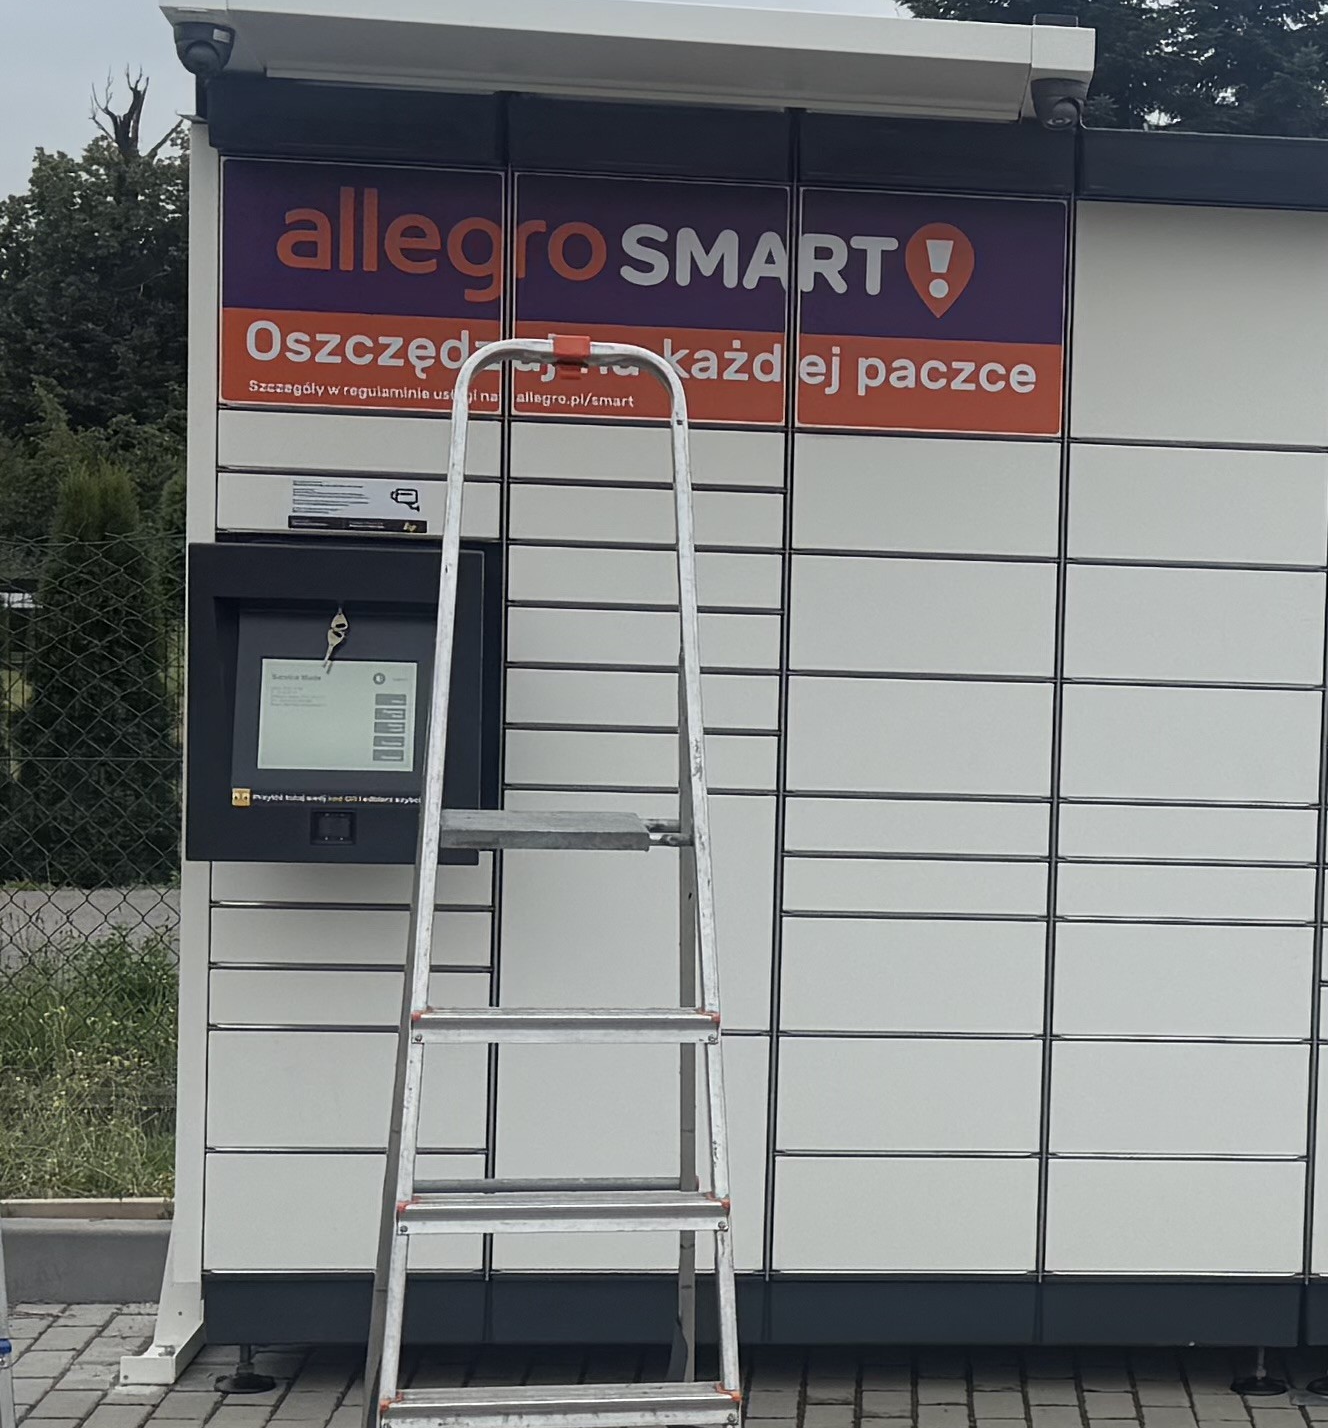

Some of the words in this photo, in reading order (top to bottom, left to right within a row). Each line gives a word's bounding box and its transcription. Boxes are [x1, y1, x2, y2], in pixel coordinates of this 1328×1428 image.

[276, 186, 608, 303] allegro
[248, 379, 324, 398] Szczegóły
[327, 385, 341, 396] w
[343, 386, 431, 400] regulaminie
[480, 391, 499, 403] na
[515, 390, 635, 409] allegro.pl/smart
[663, 338, 841, 396] każdej
[857, 356, 1038, 397] paczce
